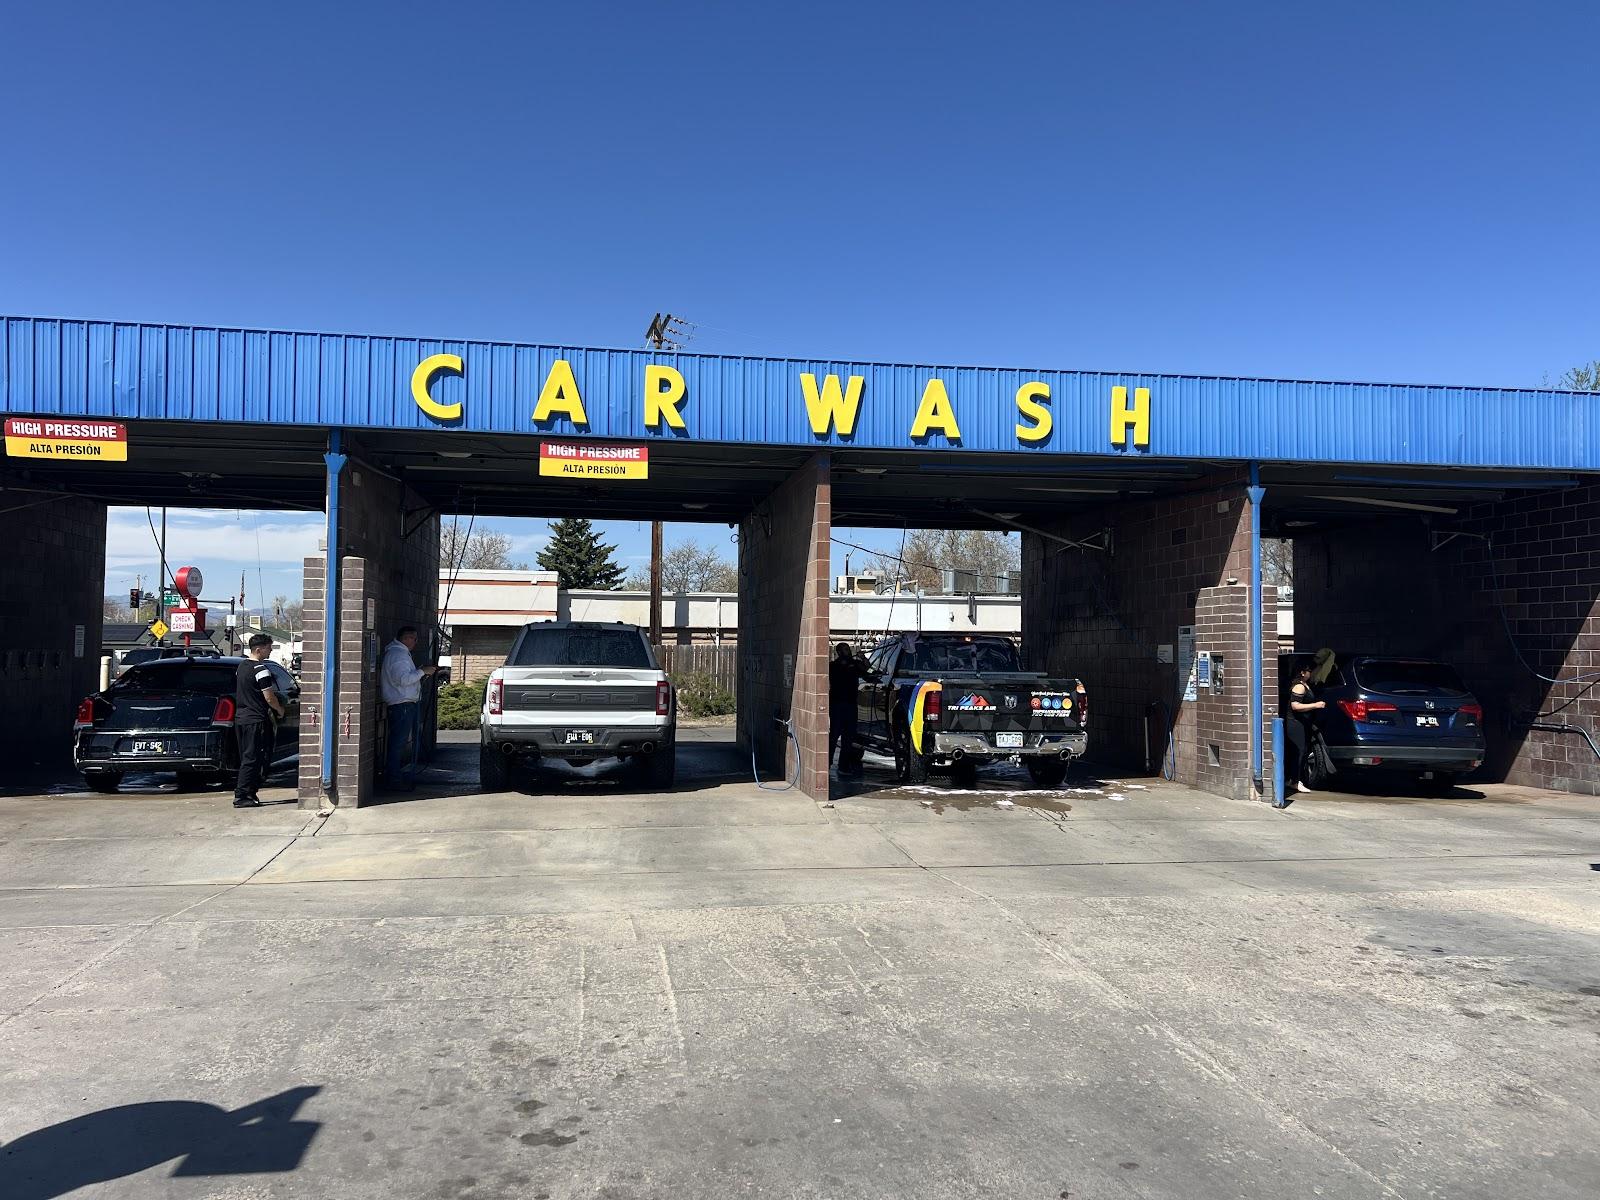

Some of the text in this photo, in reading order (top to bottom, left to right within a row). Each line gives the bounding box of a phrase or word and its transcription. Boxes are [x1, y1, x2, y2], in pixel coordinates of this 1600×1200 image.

[410, 353, 1151, 446] CAR WASH
[12, 421, 117, 439] HIGH PRESSURE
[30, 443, 101, 456] ALTA PRESIÓN
[548, 444, 641, 459] HIGH PRESSURE
[563, 463, 627, 475] ALTA PRESIÓN
[172, 622, 194, 630] CASHING
